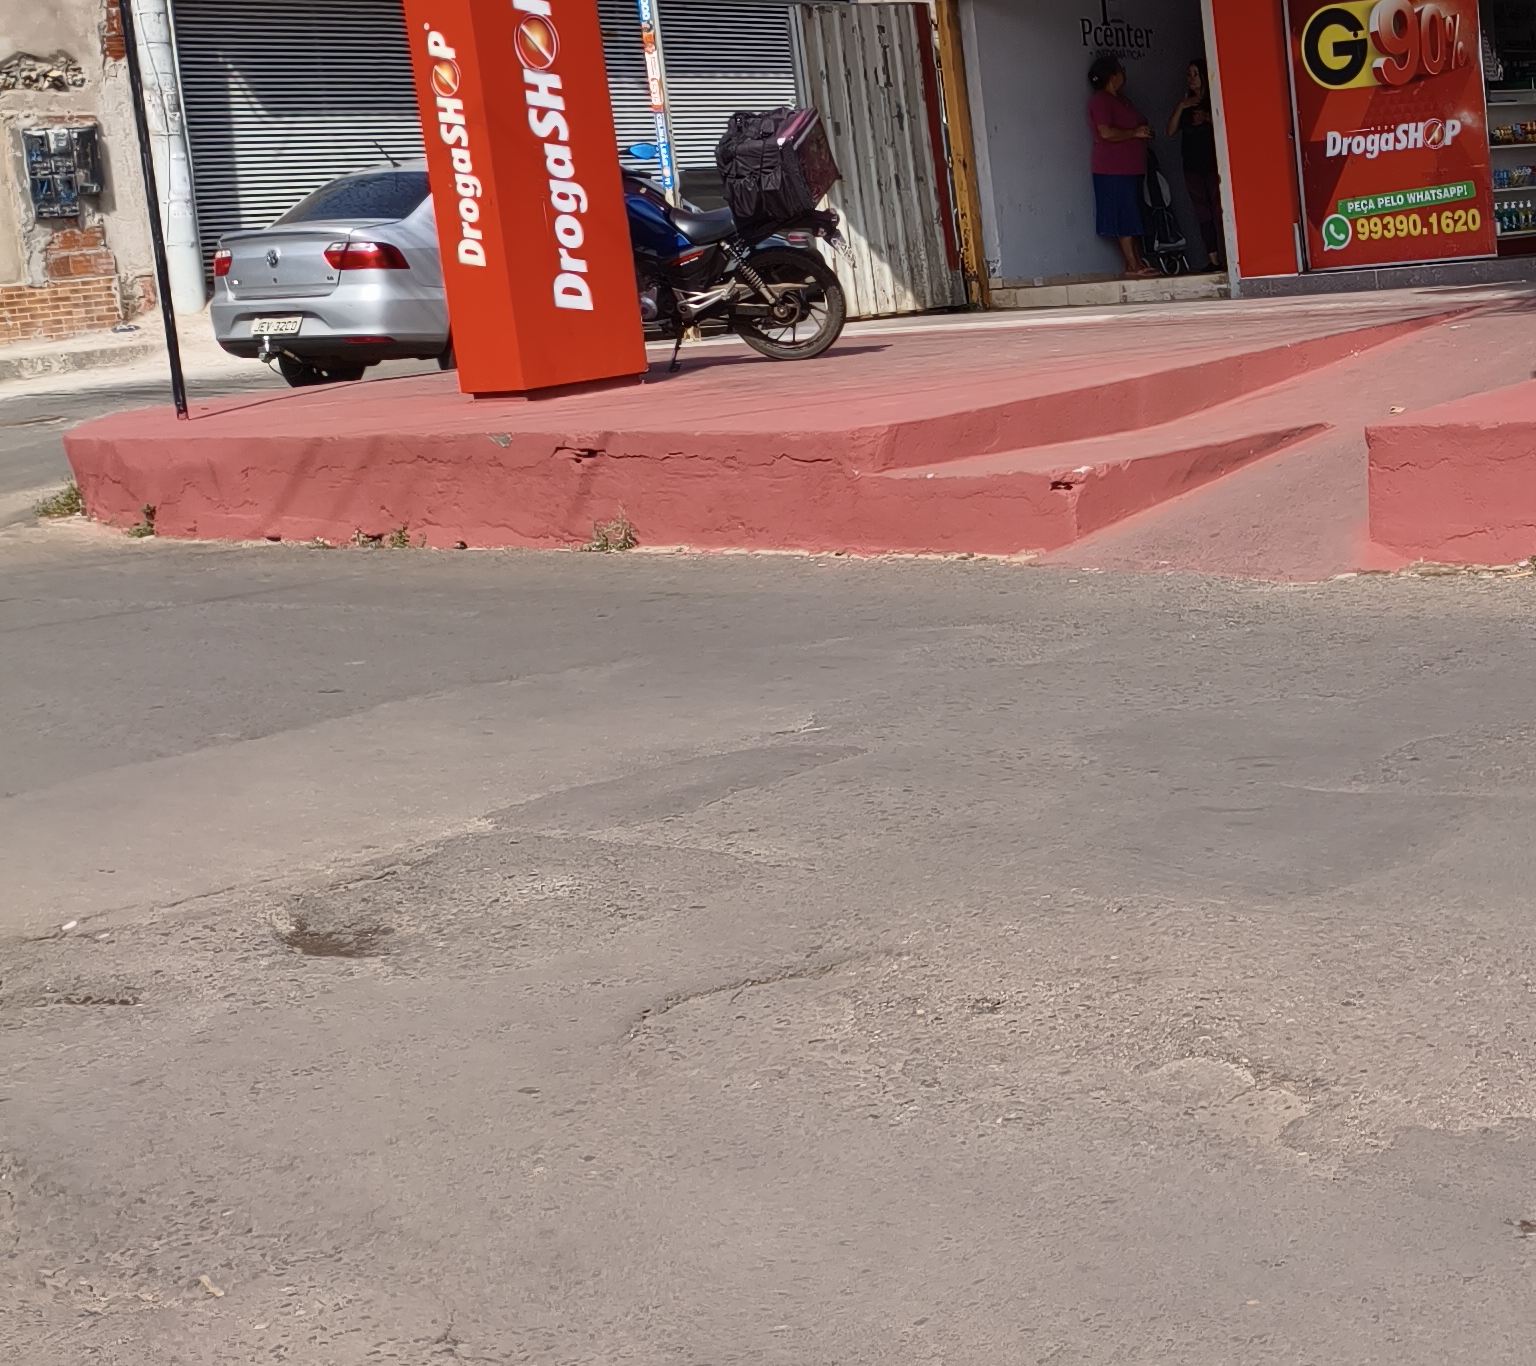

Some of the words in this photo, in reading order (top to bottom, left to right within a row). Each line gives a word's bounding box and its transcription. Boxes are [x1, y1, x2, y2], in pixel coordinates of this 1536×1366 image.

[1080, 18, 1154, 48] Pcenter
[427, 30, 487, 267] DrogaSHOP
[1326, 118, 1461, 159] DrogaSHOP
[1347, 197, 1375, 213] PEÇA
[1377, 194, 1404, 209] PELO
[1406, 185, 1468, 204] WHATSAPP!
[1356, 208, 1481, 241] 99390.1620
